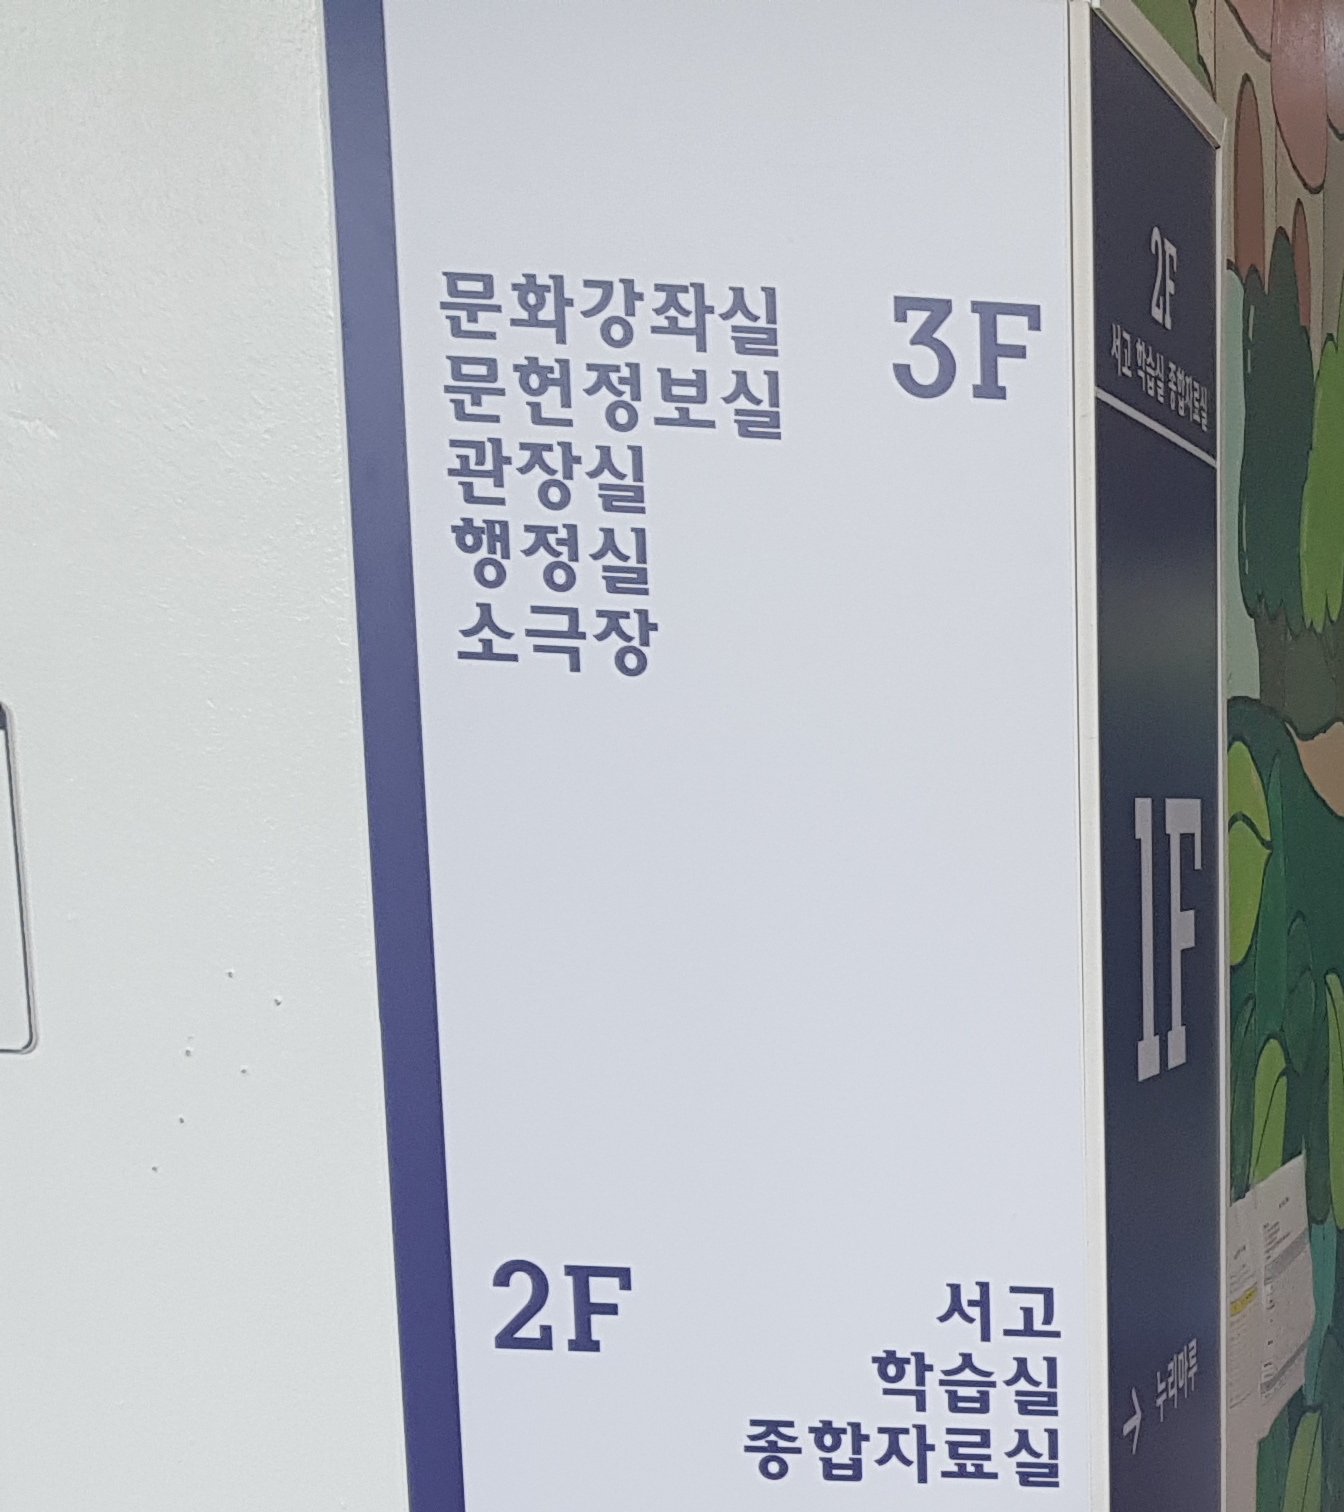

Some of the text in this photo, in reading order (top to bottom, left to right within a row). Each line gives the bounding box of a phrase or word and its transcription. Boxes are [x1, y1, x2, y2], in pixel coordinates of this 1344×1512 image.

[439, 270, 779, 358] 문화강좌실
[1151, 226, 1178, 331] 2F
[892, 295, 1041, 401] 3F
[1111, 323, 1208, 432] 서고 학습실 종합자료실
[443, 354, 782, 440] 문헌정보실
[447, 437, 647, 514] 관장실
[451, 518, 649, 595] 행정실
[457, 602, 658, 677] 소극장
[1134, 797, 1202, 1083] 1F
[492, 1259, 632, 1353] 2F
[936, 1281, 1061, 1342] 서고
[871, 1348, 1060, 1416] 학습실
[1155, 1338, 1199, 1423] 누리마루
[744, 1418, 1060, 1487] 종합자료실
